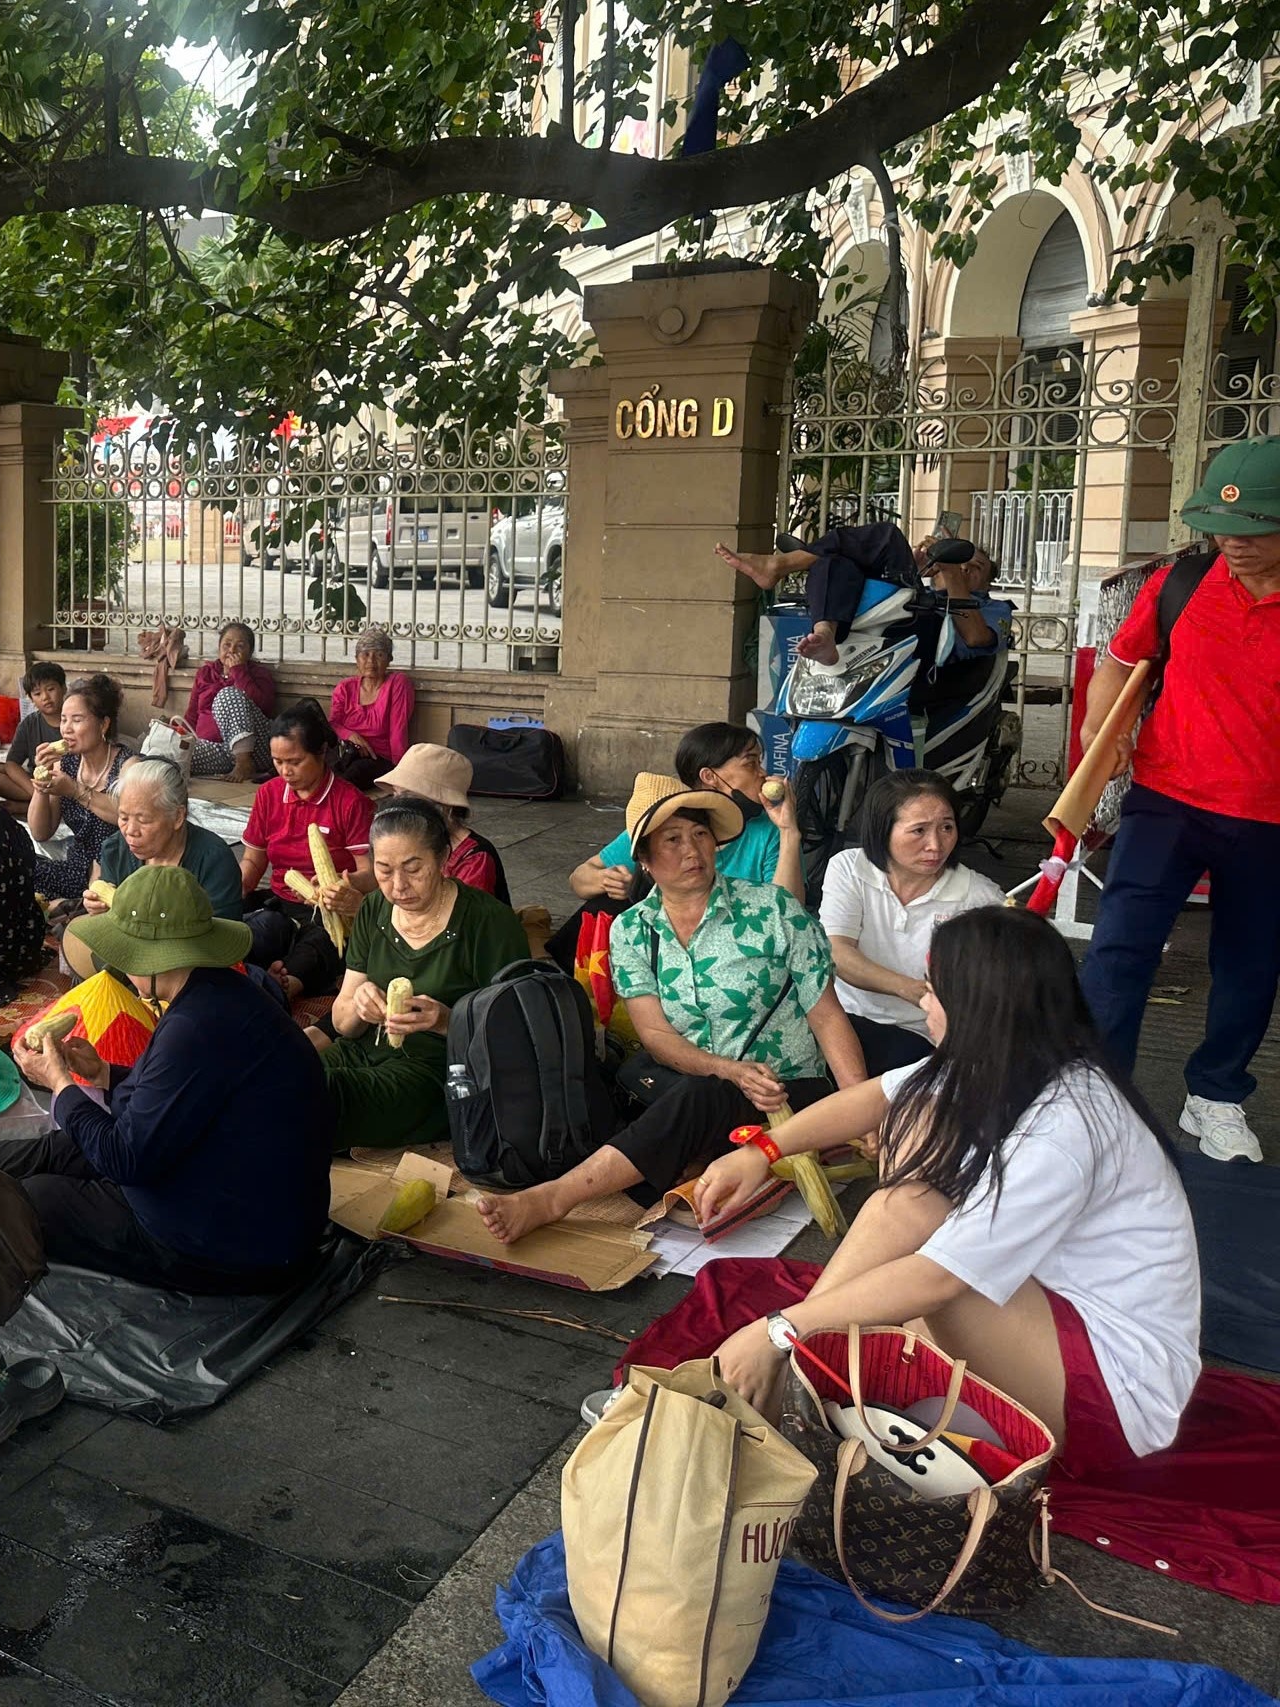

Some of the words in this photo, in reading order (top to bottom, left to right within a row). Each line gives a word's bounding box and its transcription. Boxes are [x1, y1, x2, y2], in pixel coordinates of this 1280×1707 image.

[615, 383, 698, 439] CỔNG
[711, 397, 734, 437] D
[772, 731, 792, 777] UAFINA
